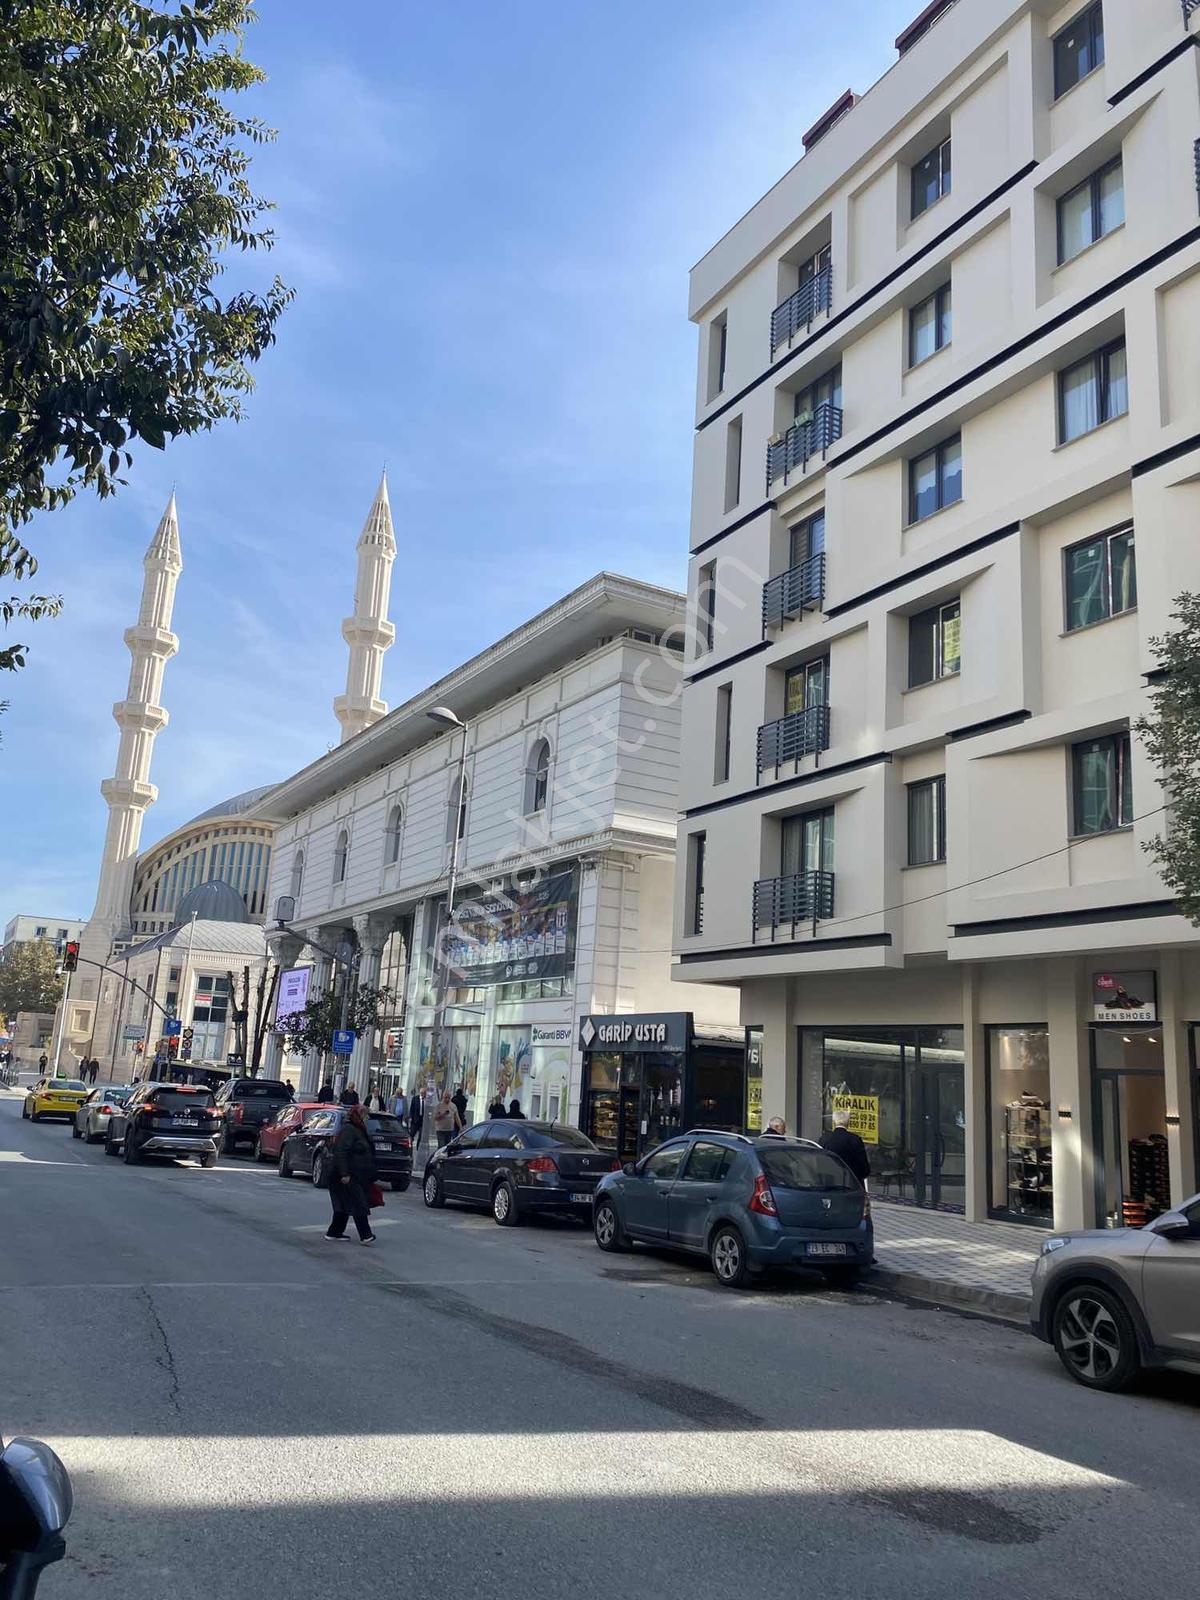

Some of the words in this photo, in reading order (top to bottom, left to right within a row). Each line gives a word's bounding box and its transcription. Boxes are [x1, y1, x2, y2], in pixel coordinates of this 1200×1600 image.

[1098, 1012, 1117, 1020] MEN
[1119, 1012, 1151, 1020] SHOES
[537, 1028, 556, 1040] Garanti
[599, 1021, 632, 1043] GARİP
[635, 1023, 666, 1043] USTA
[835, 1096, 875, 1111] KİRALIK
